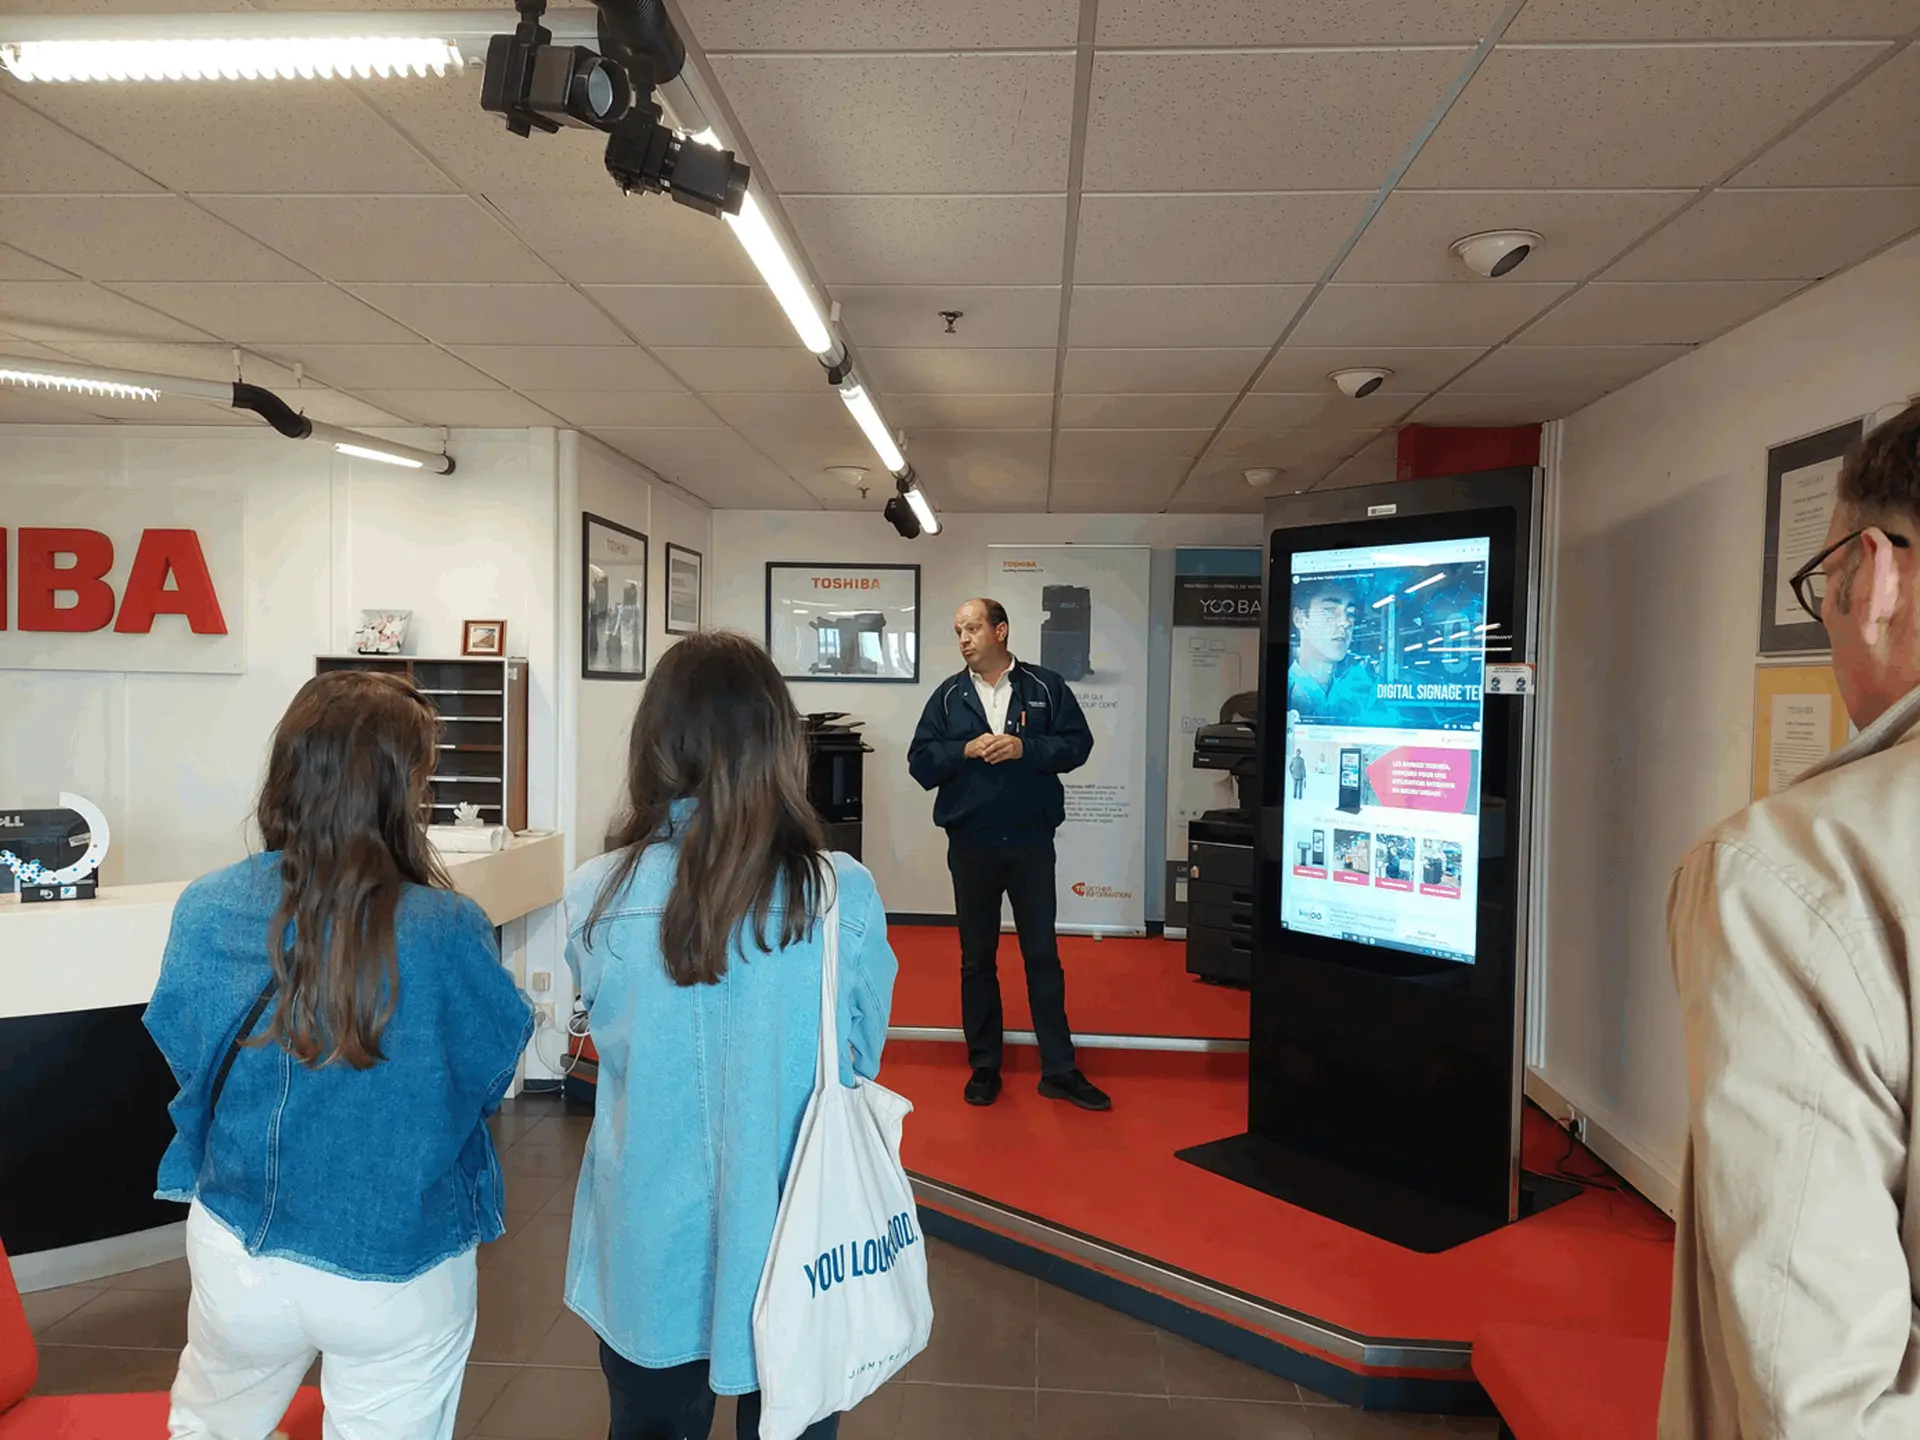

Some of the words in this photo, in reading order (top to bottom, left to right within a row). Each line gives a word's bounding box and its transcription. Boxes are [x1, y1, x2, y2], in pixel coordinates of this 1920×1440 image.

[0, 526, 228, 635] BA
[811, 577, 881, 590] TOSHIBA
[1377, 684, 1414, 699] DIGITAL
[1417, 684, 1462, 700] SIGNAGE
[1465, 685, 1482, 700] TE
[803, 1244, 845, 1299] YOU
